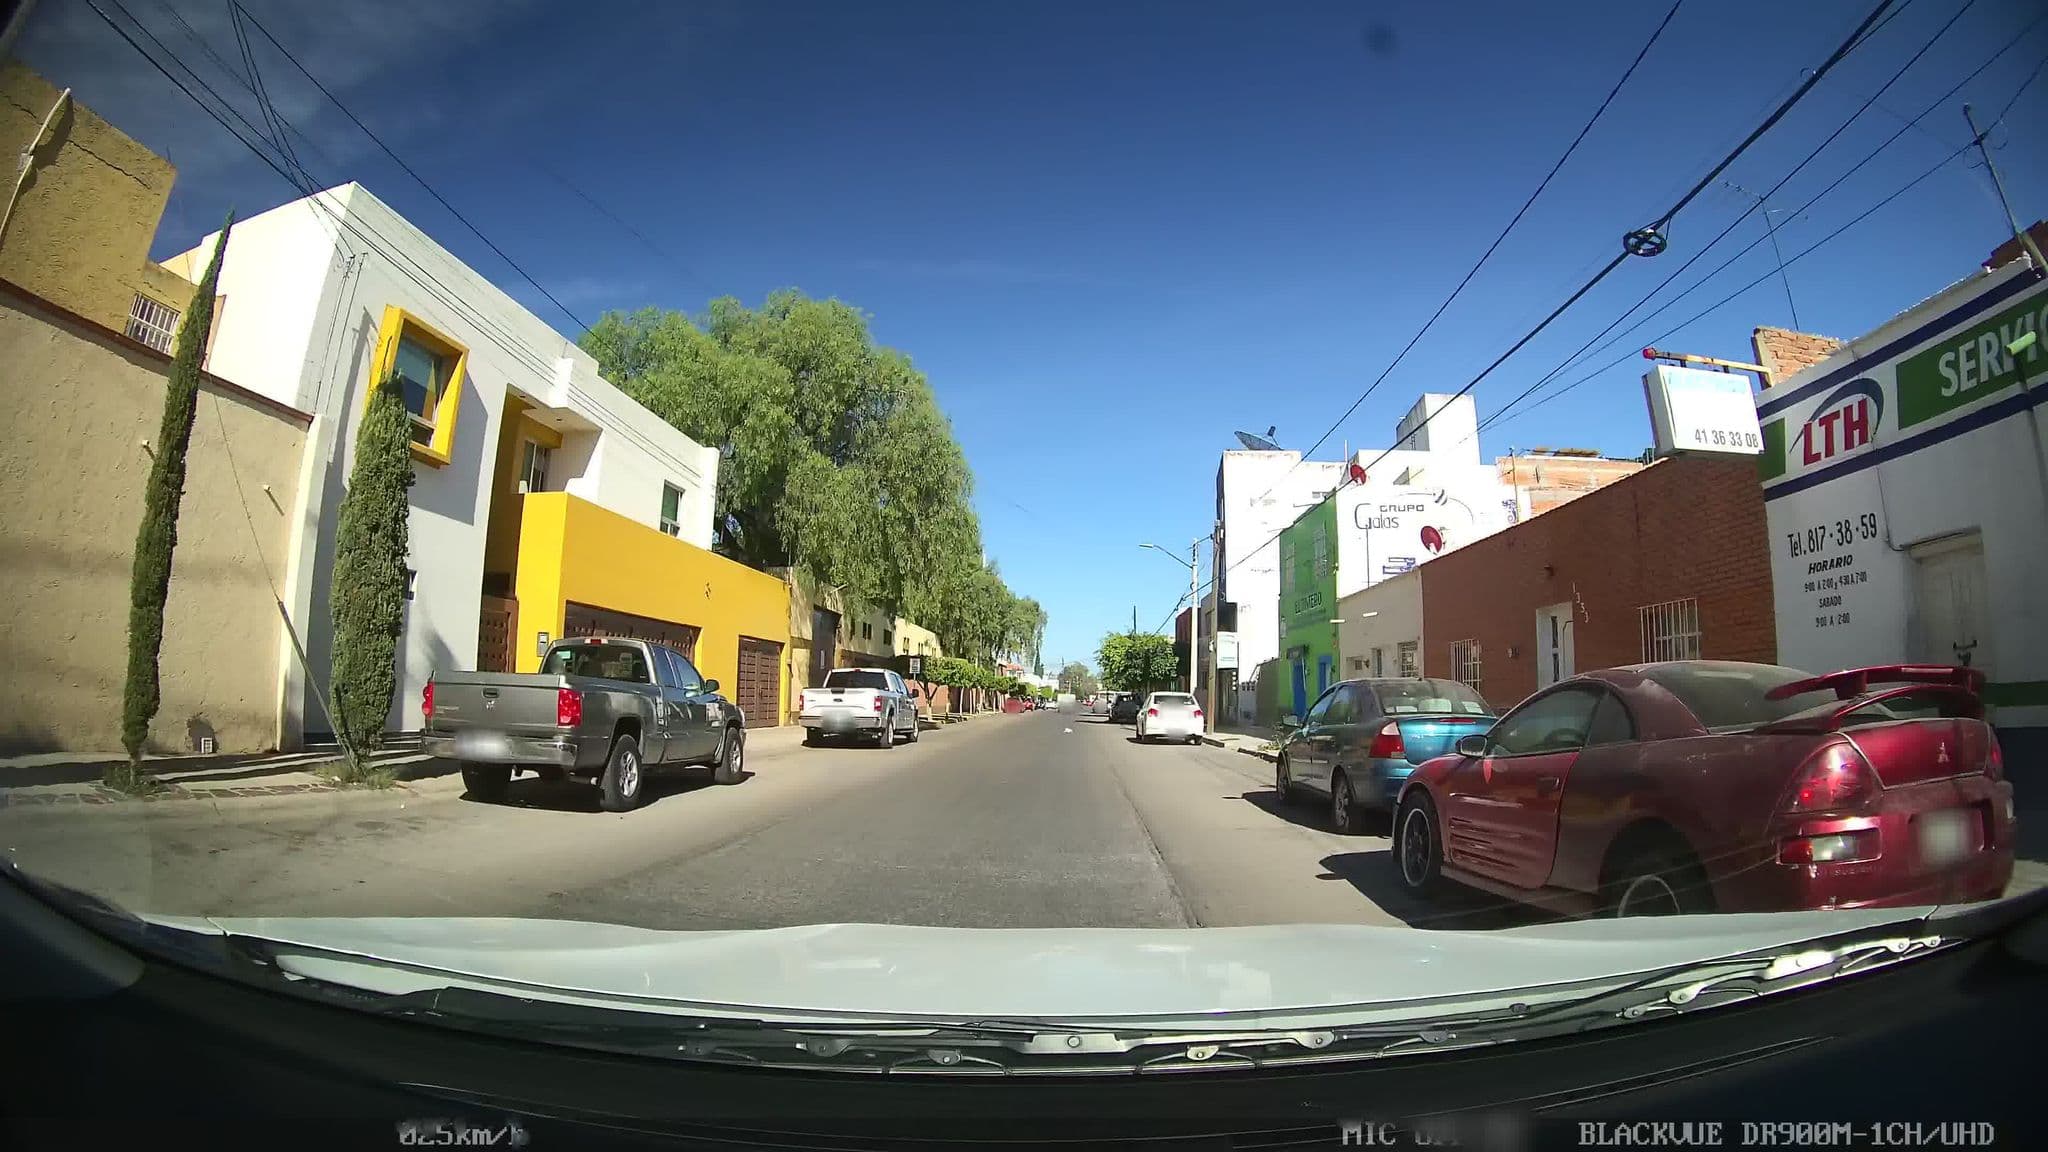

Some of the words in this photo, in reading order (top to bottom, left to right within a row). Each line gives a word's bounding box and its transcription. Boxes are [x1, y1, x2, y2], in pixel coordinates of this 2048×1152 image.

[1694, 429, 1708, 444] 41
[1711, 430, 1726, 445] 36
[1729, 431, 1743, 447] 33
[1803, 398, 1869, 466] LTH
[1379, 504, 1425, 513] GRUPO
[1787, 531, 1807, 559] Tel.
[1807, 554, 1853, 575] HORARIO
